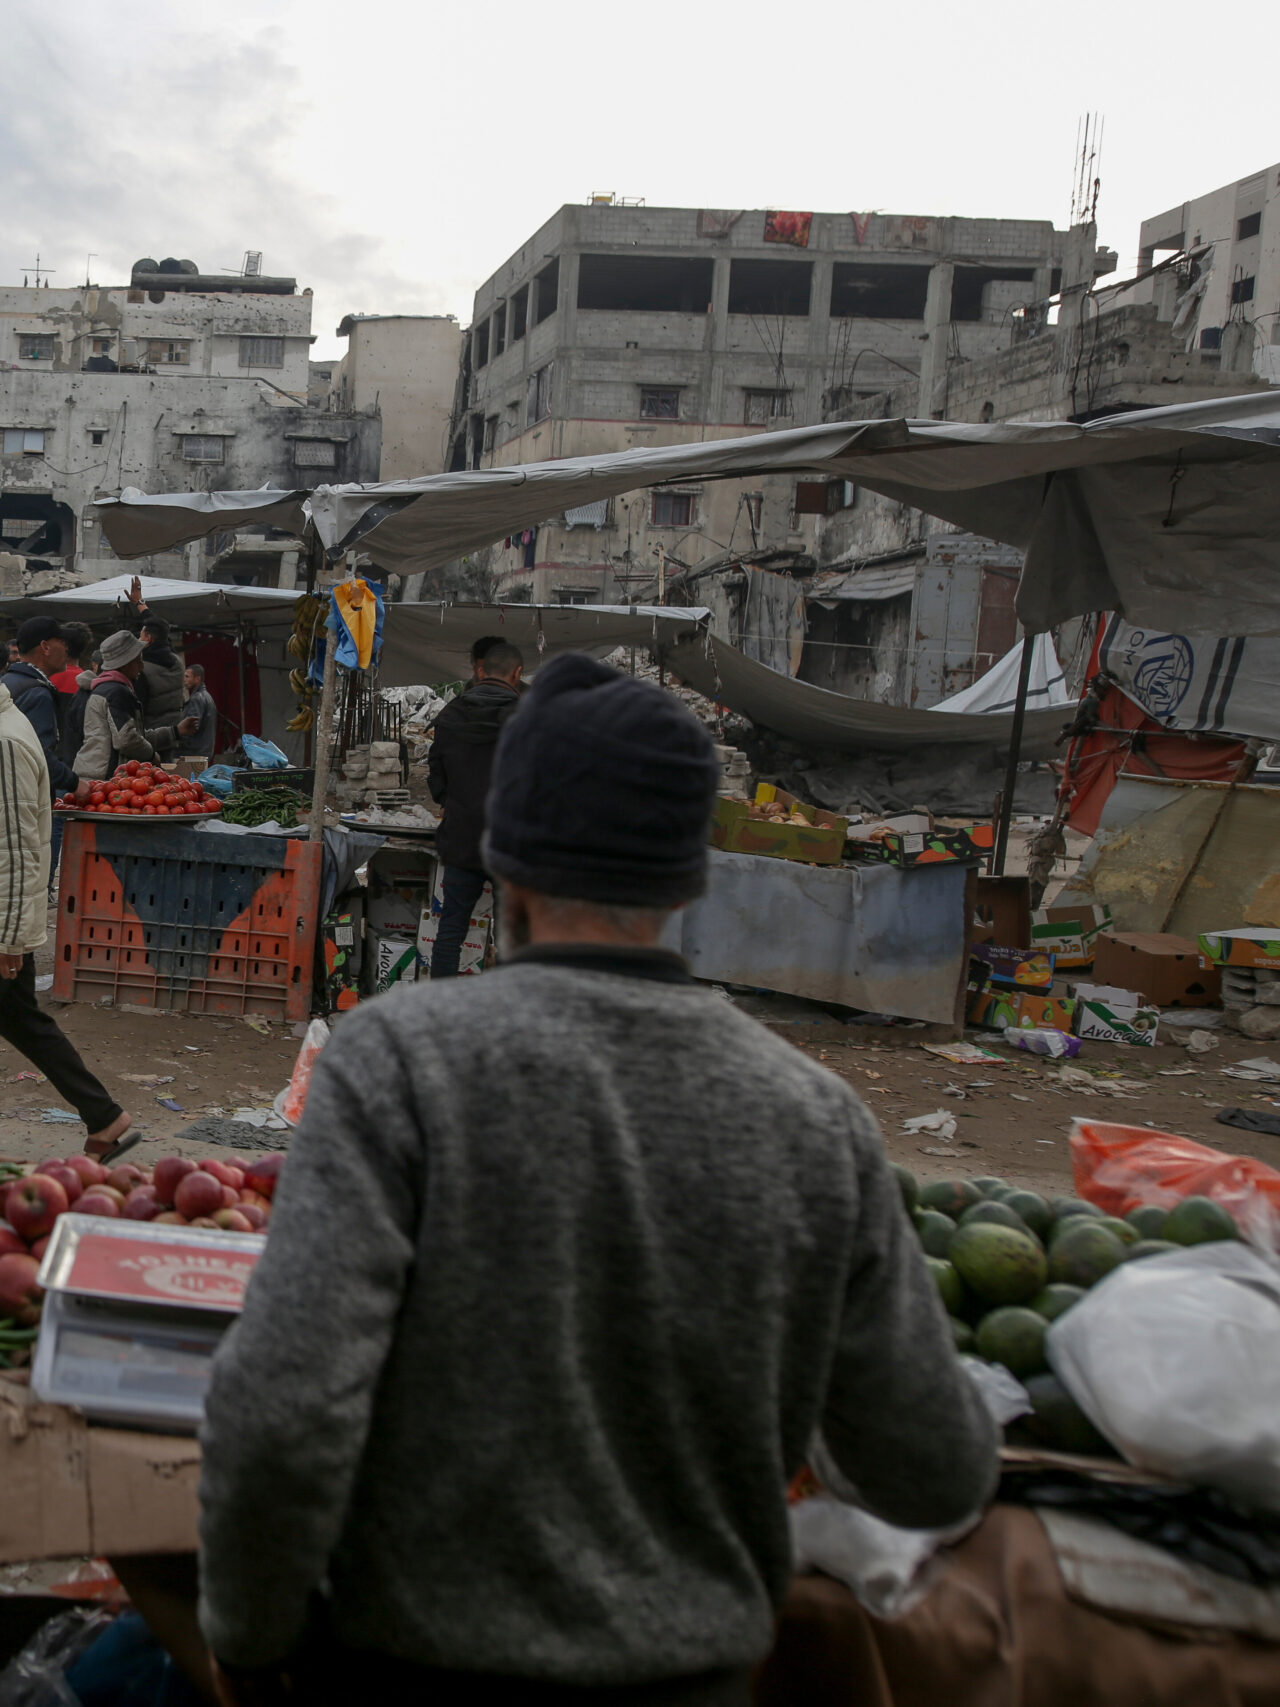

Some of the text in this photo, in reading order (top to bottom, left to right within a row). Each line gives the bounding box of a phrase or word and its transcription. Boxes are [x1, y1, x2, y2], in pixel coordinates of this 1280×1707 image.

[1123, 630, 1145, 666] OM
[378, 943, 394, 992] Avoca
[1081, 1024, 1153, 1046] Avocado
